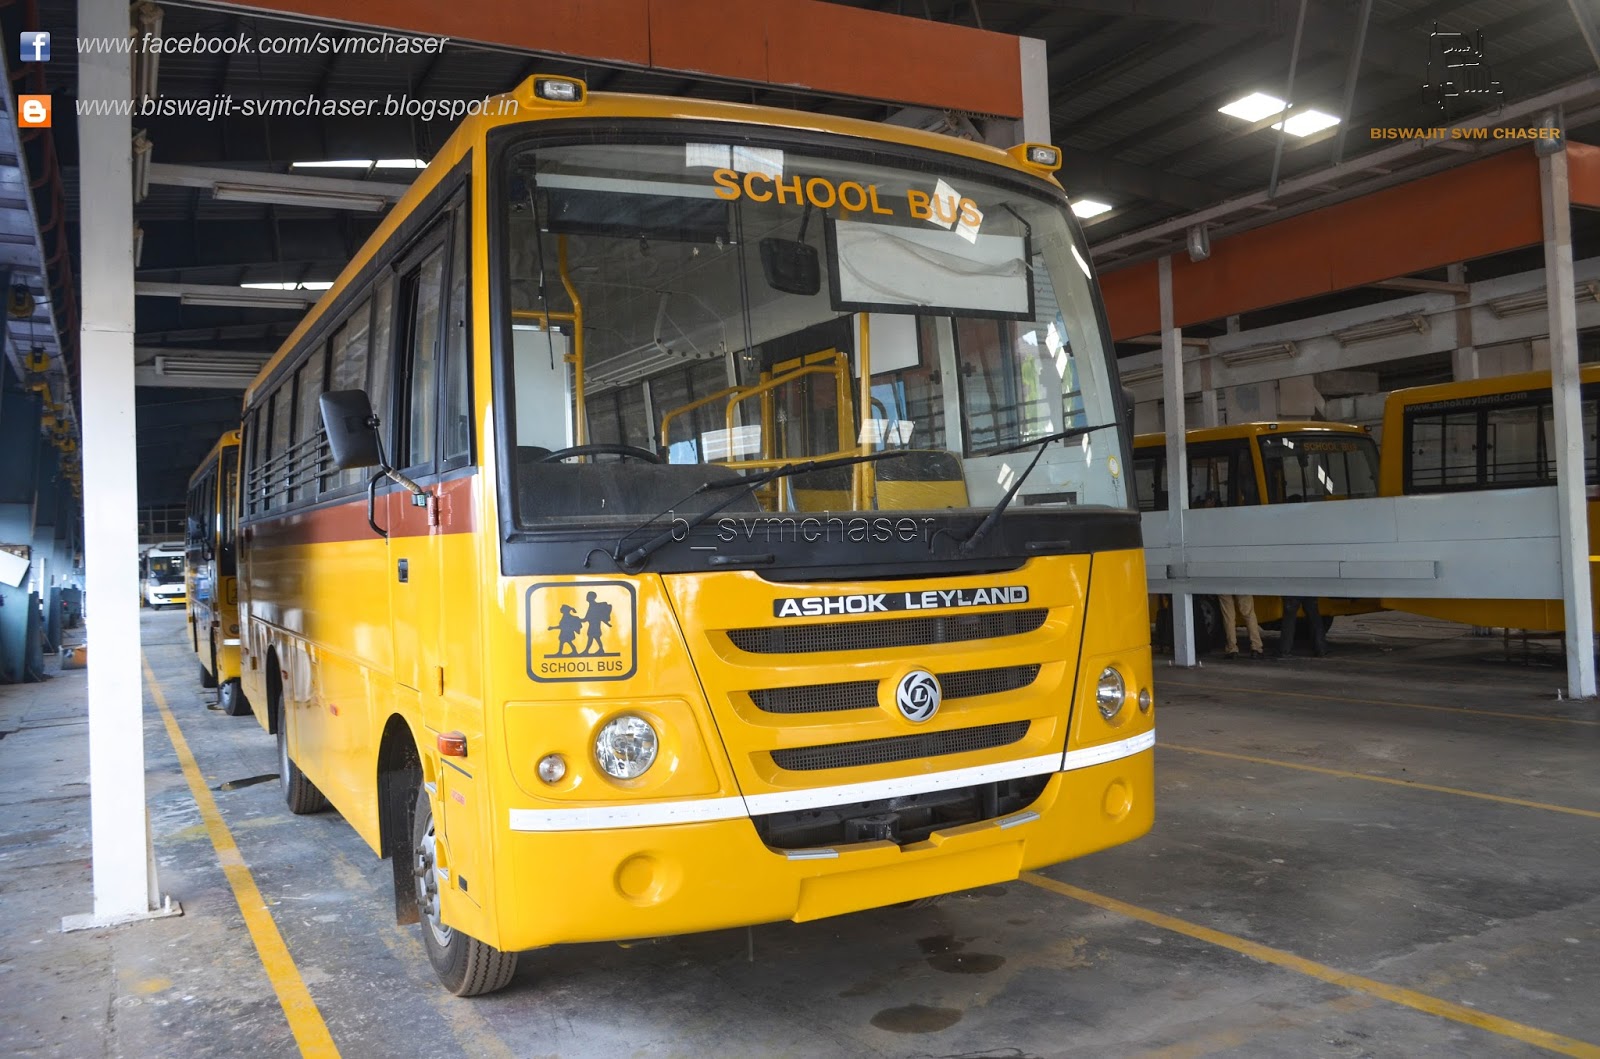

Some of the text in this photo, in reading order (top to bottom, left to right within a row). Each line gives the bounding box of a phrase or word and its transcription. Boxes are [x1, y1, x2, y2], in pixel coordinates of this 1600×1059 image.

[712, 168, 981, 227] SCHOOL BUS
[1405, 392, 1528, 412] www.ashokleyland.com
[778, 586, 1028, 617] ASHOK LEYLAND
[540, 660, 623, 674] SCHOOL BUS
